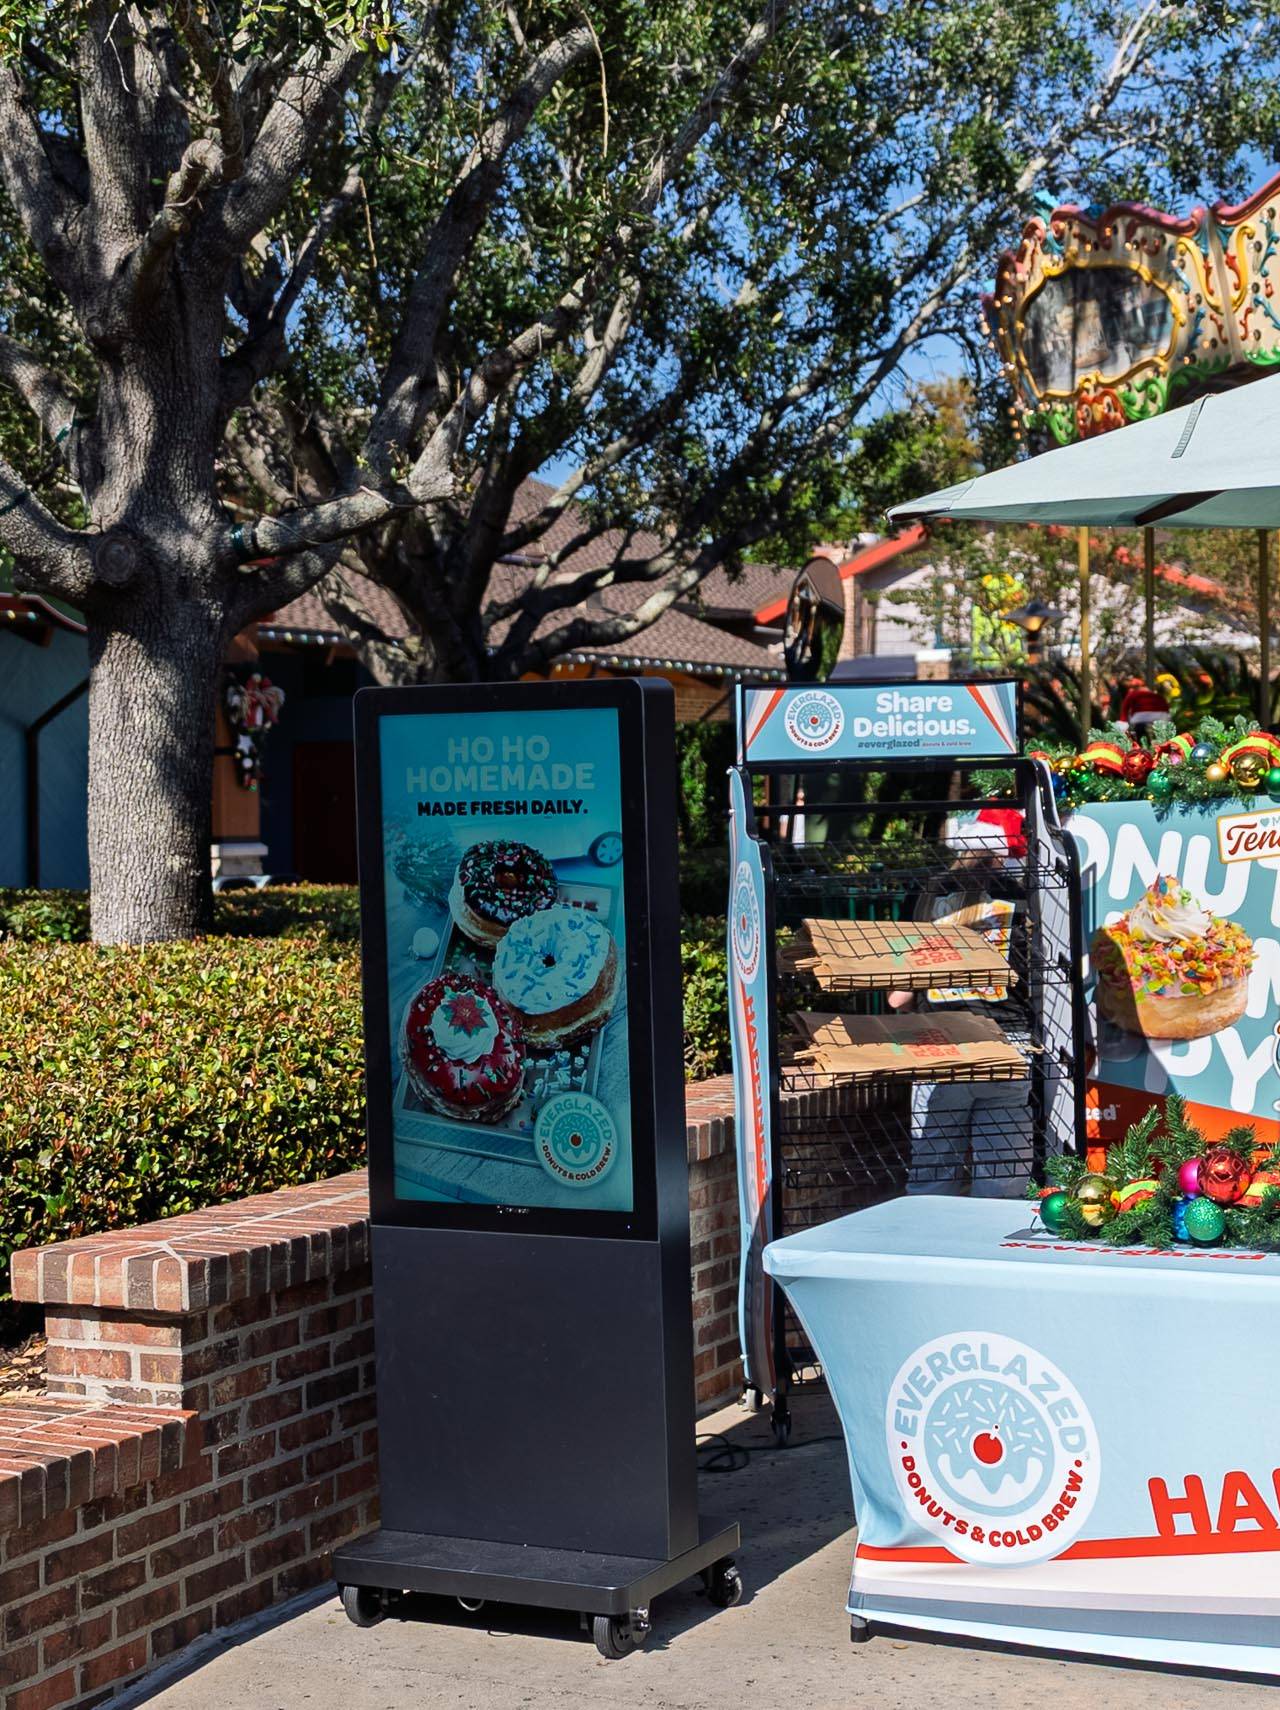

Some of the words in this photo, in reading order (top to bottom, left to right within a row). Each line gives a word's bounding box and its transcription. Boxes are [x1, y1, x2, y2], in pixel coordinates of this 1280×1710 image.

[787, 692, 841, 720] EVERGLAZED
[876, 691, 953, 714] Share
[853, 714, 976, 739] Delicious.
[448, 736, 494, 764] HO
[501, 735, 550, 762] HO
[406, 763, 595, 793] HOMEMADE
[417, 801, 468, 816] MADE
[470, 800, 528, 815] FRESH
[531, 799, 588, 815] DAILY.
[540, 1098, 612, 1140] EVERGLAZED
[543, 1145, 568, 1178] DONUTS
[575, 1170, 596, 1180] COLD
[595, 1146, 611, 1173] BREW
[894, 1343, 1087, 1453] EVERGLAZED
[902, 1455, 969, 1535] DONUTS
[971, 1526, 986, 1543] &
[989, 1524, 1043, 1547] COLD
[1041, 1469, 1083, 1532] BREW
